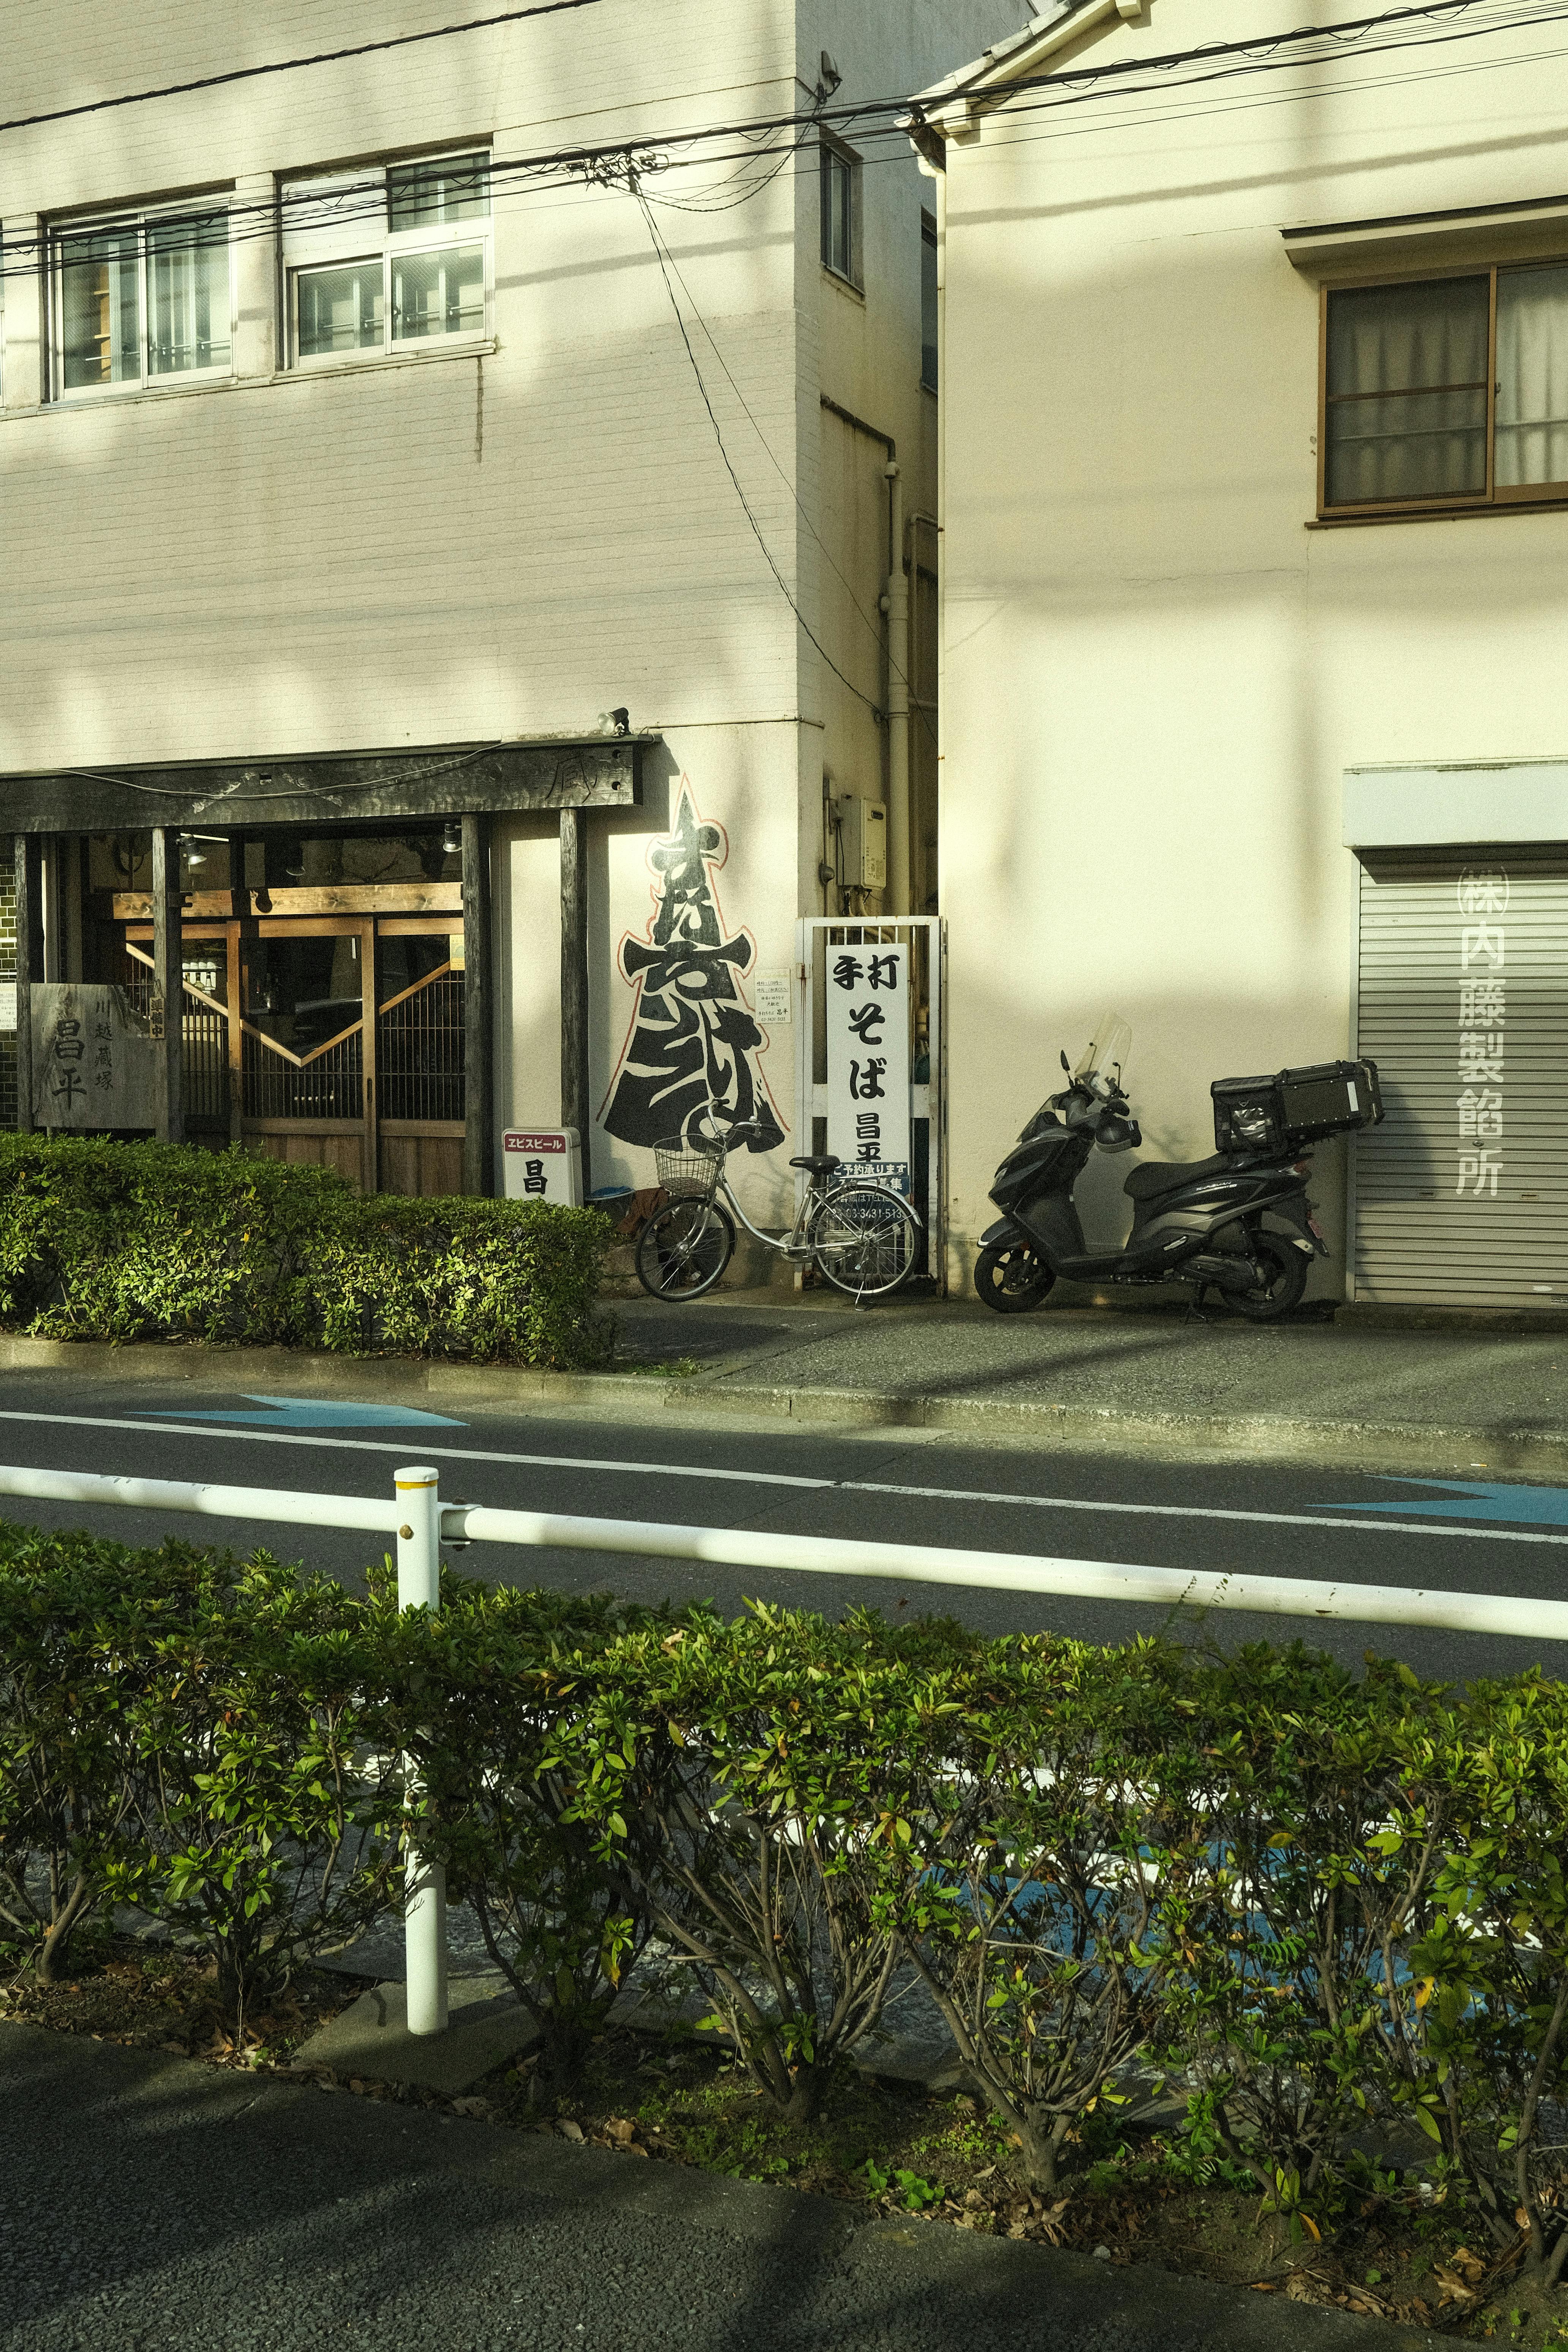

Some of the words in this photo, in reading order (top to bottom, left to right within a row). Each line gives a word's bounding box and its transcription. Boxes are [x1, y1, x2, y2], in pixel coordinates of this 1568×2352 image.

[833, 954, 900, 990] 手打
[150, 998, 163, 1037] 準備中
[52, 1018, 87, 1111] 昌平
[848, 1002, 887, 1100] そば
[855, 1112, 881, 1162] 昌平
[833, 1164, 906, 1176] ご予約承ります
